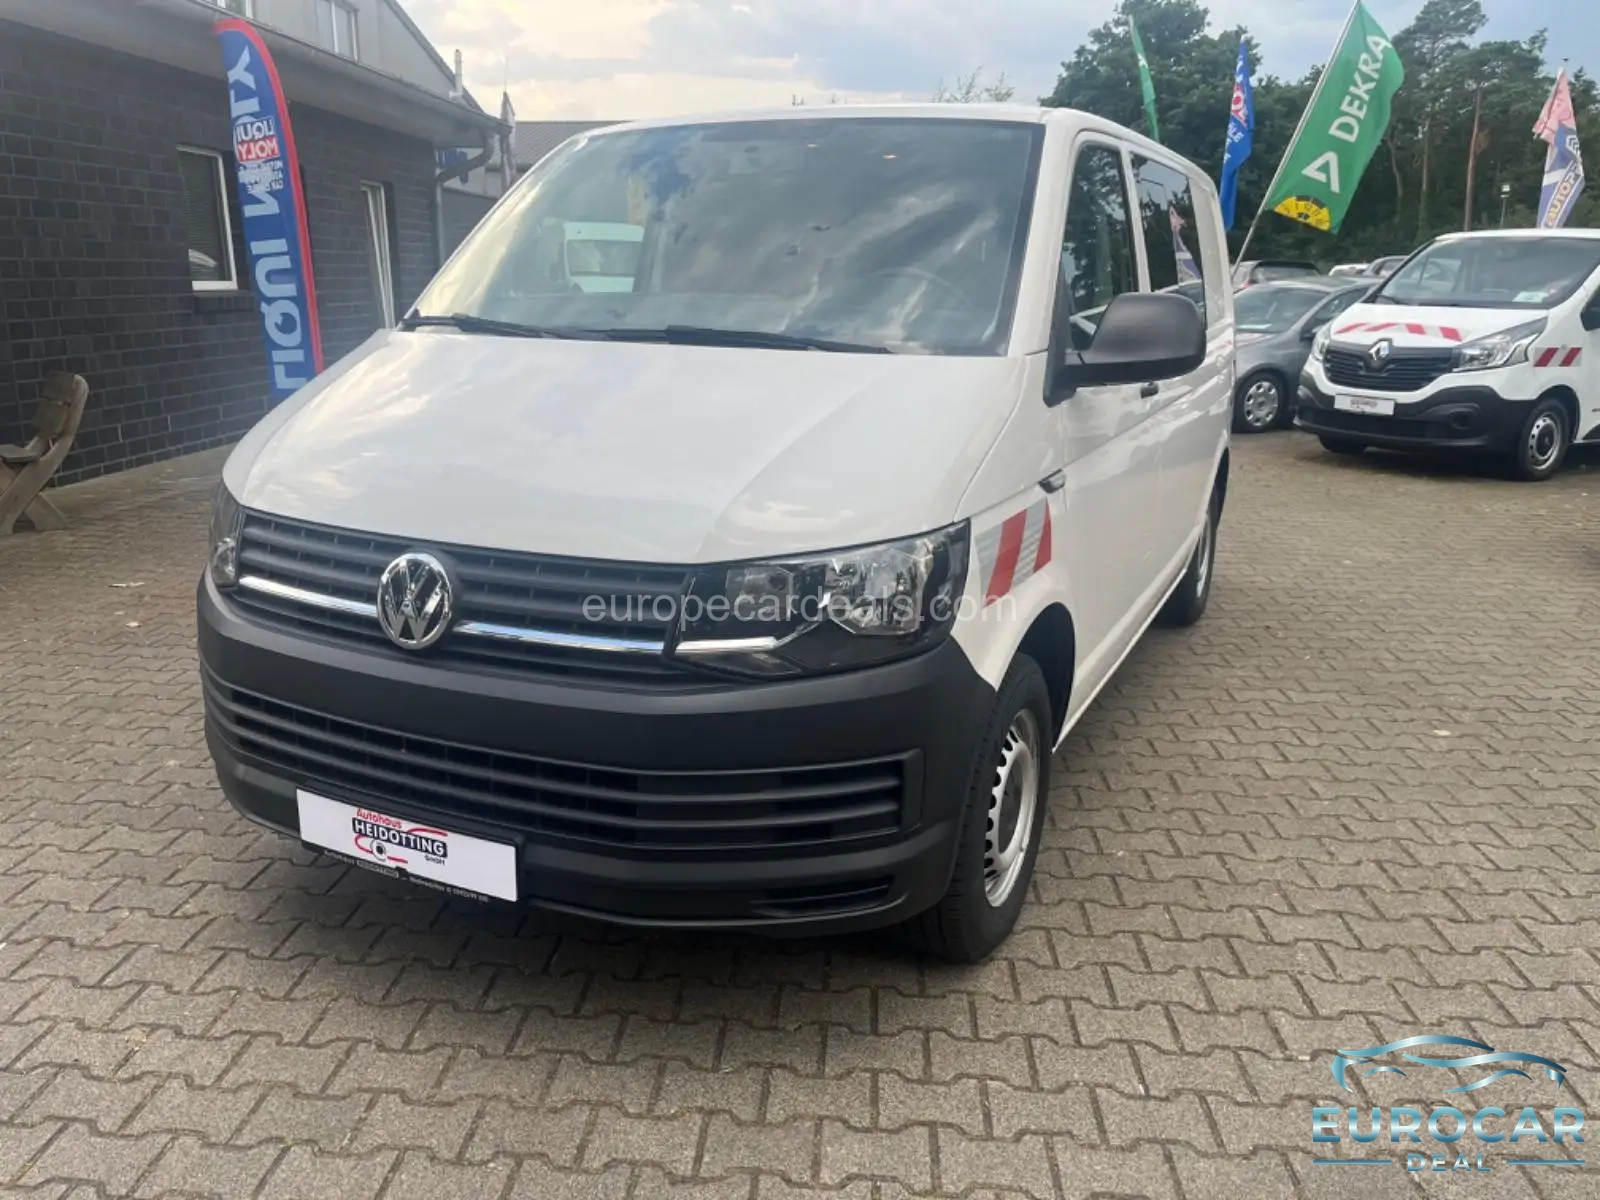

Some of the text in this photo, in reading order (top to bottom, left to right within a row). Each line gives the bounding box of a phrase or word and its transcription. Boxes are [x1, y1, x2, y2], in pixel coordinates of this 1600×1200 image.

[1329, 34, 1393, 143] DEKRA
[356, 808, 403, 829] Autohaus
[354, 819, 444, 856] HEIDOTTING
